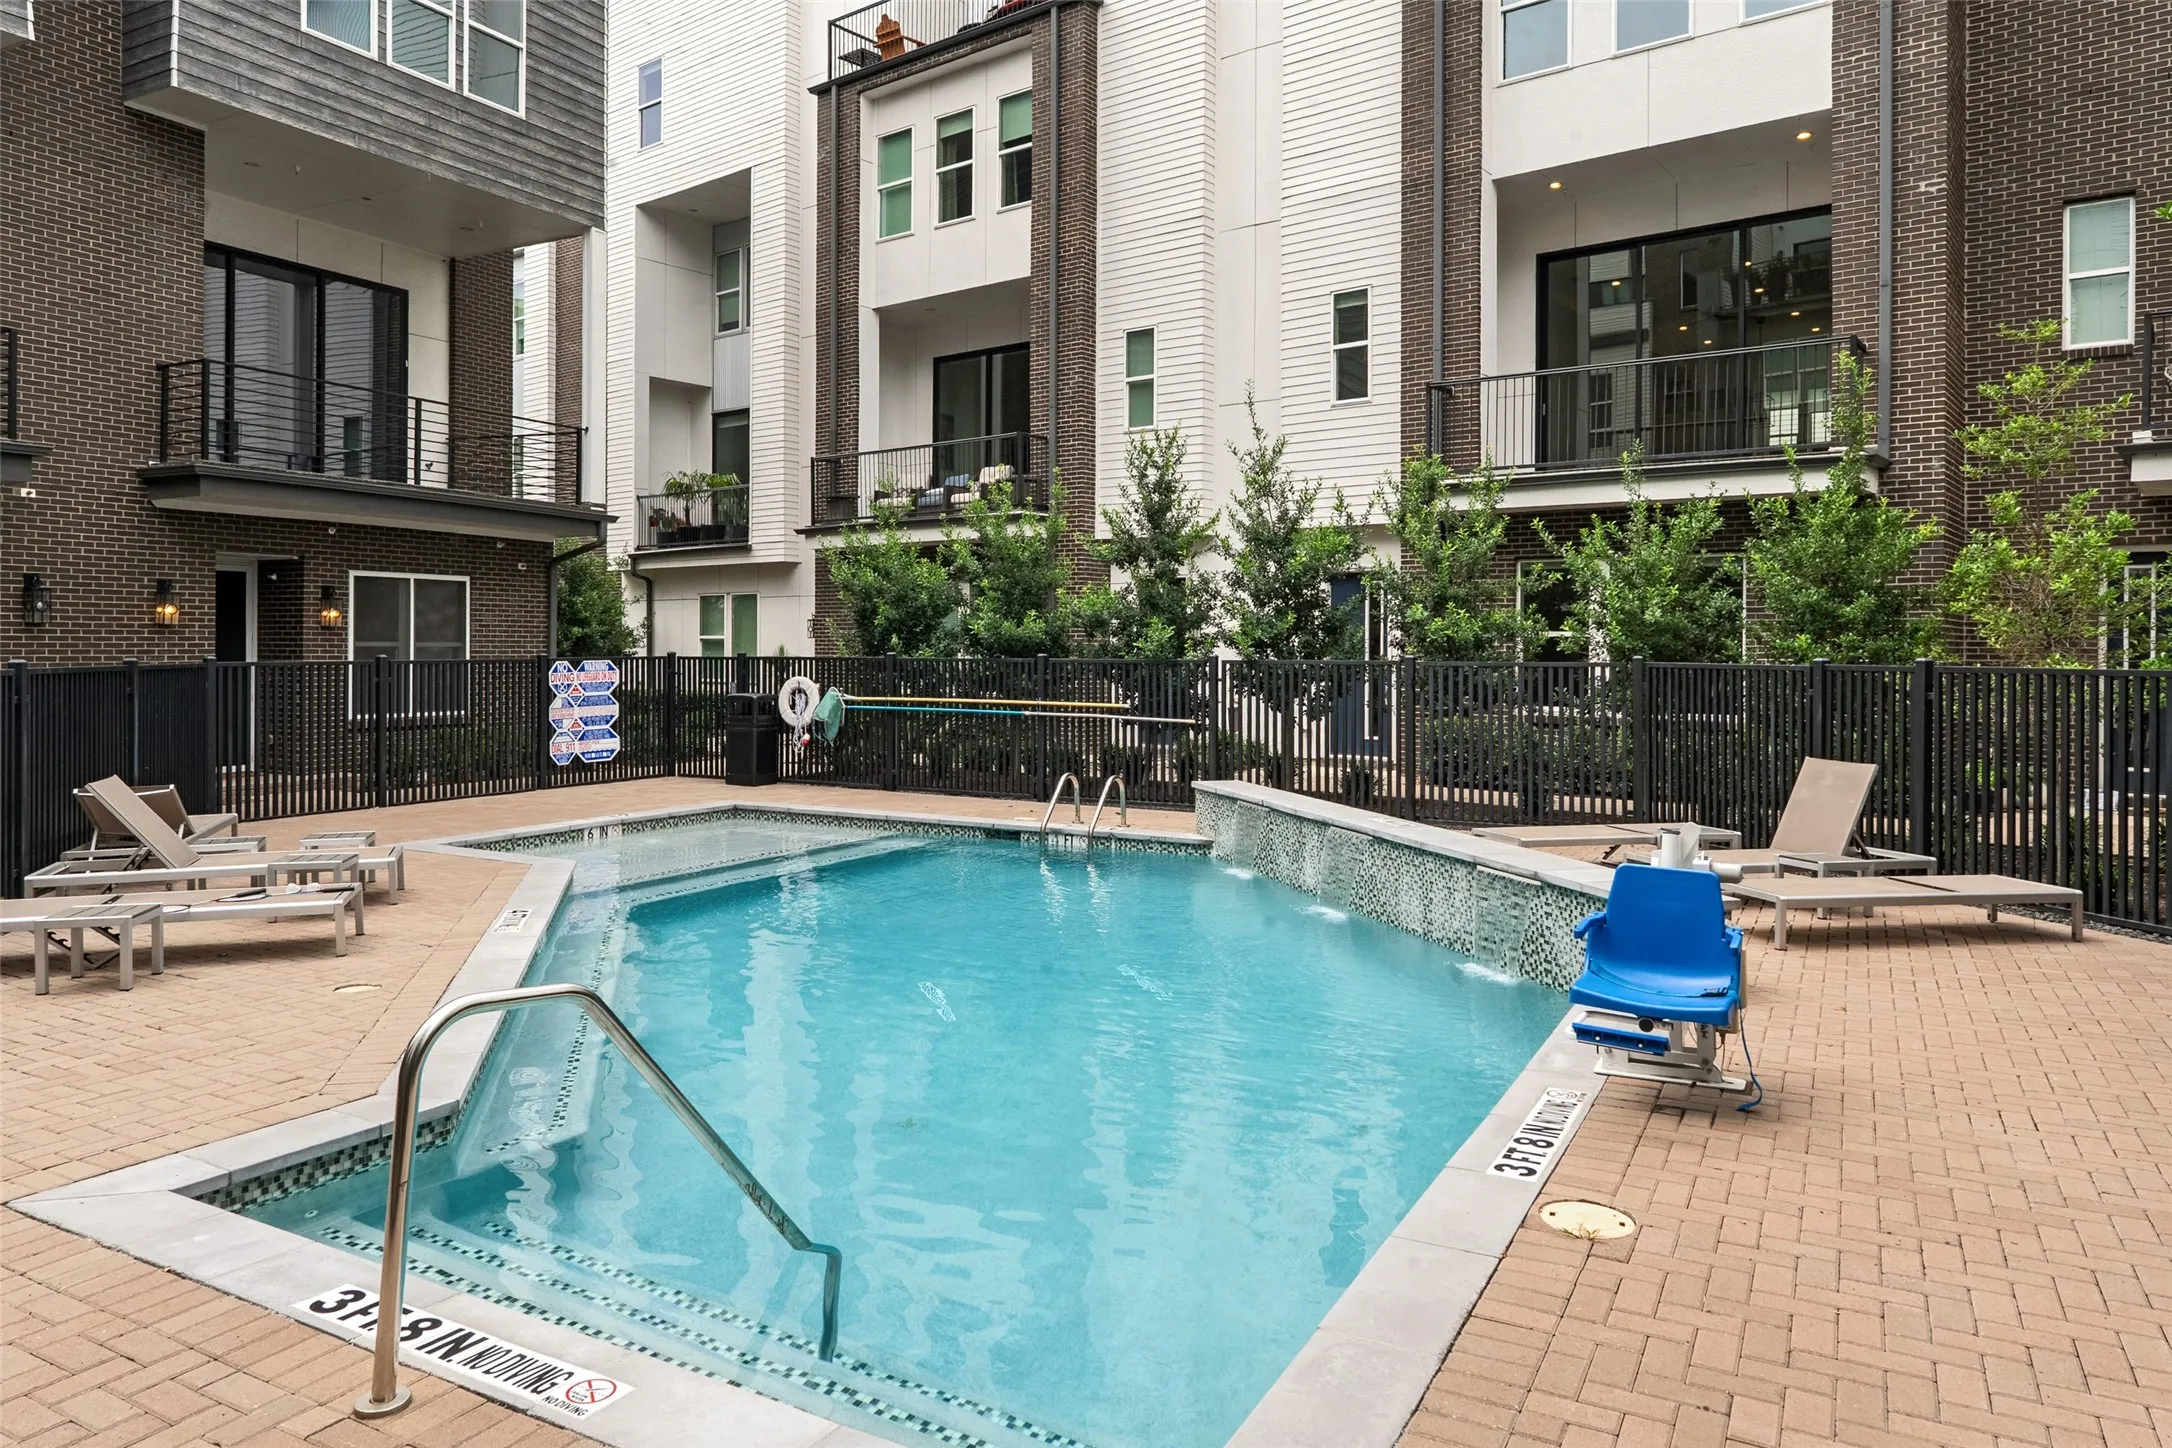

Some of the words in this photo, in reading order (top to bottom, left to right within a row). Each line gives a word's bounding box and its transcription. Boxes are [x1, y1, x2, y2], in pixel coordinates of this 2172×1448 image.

[557, 662, 568, 673] NO
[584, 662, 609, 672] WARNING
[551, 673, 575, 683] DIVING
[552, 743, 563, 754] DIAL
[566, 742, 575, 752] 911
[587, 828, 594, 839] 6
[599, 826, 608, 837] IN
[1064, 834, 1075, 846] FT
[1513, 1137, 1555, 1149] 8
[1494, 1163, 1537, 1177] 3
[309, 1289, 366, 1314] 3
[400, 1317, 443, 1342] 8
[414, 1327, 489, 1363] IN.
[456, 1344, 513, 1370] NO
[481, 1353, 575, 1395] DIVING
[541, 1395, 558, 1404] NO
[554, 1400, 588, 1416] DIVING
